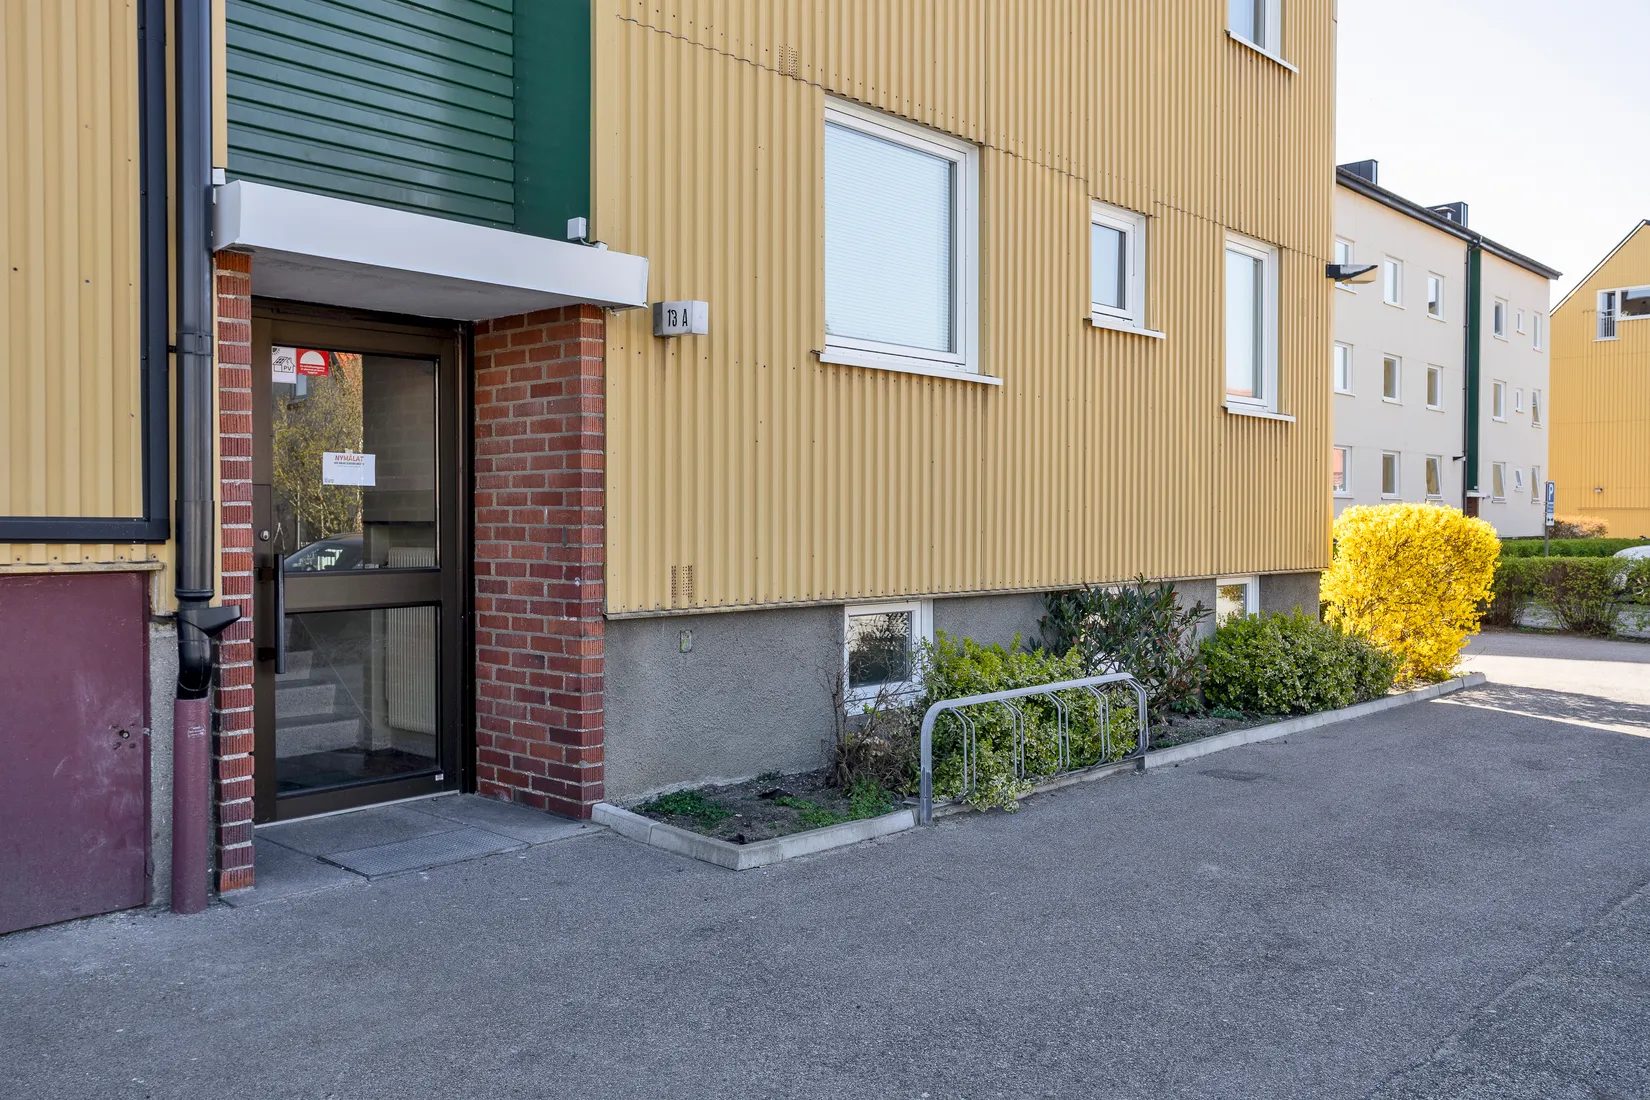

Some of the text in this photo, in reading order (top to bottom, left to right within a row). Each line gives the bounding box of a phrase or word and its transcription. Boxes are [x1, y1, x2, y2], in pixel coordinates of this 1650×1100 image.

[667, 308, 688, 327] 13 A
[335, 454, 364, 462] NYMÅLAT
[1549, 483, 1554, 501] P
